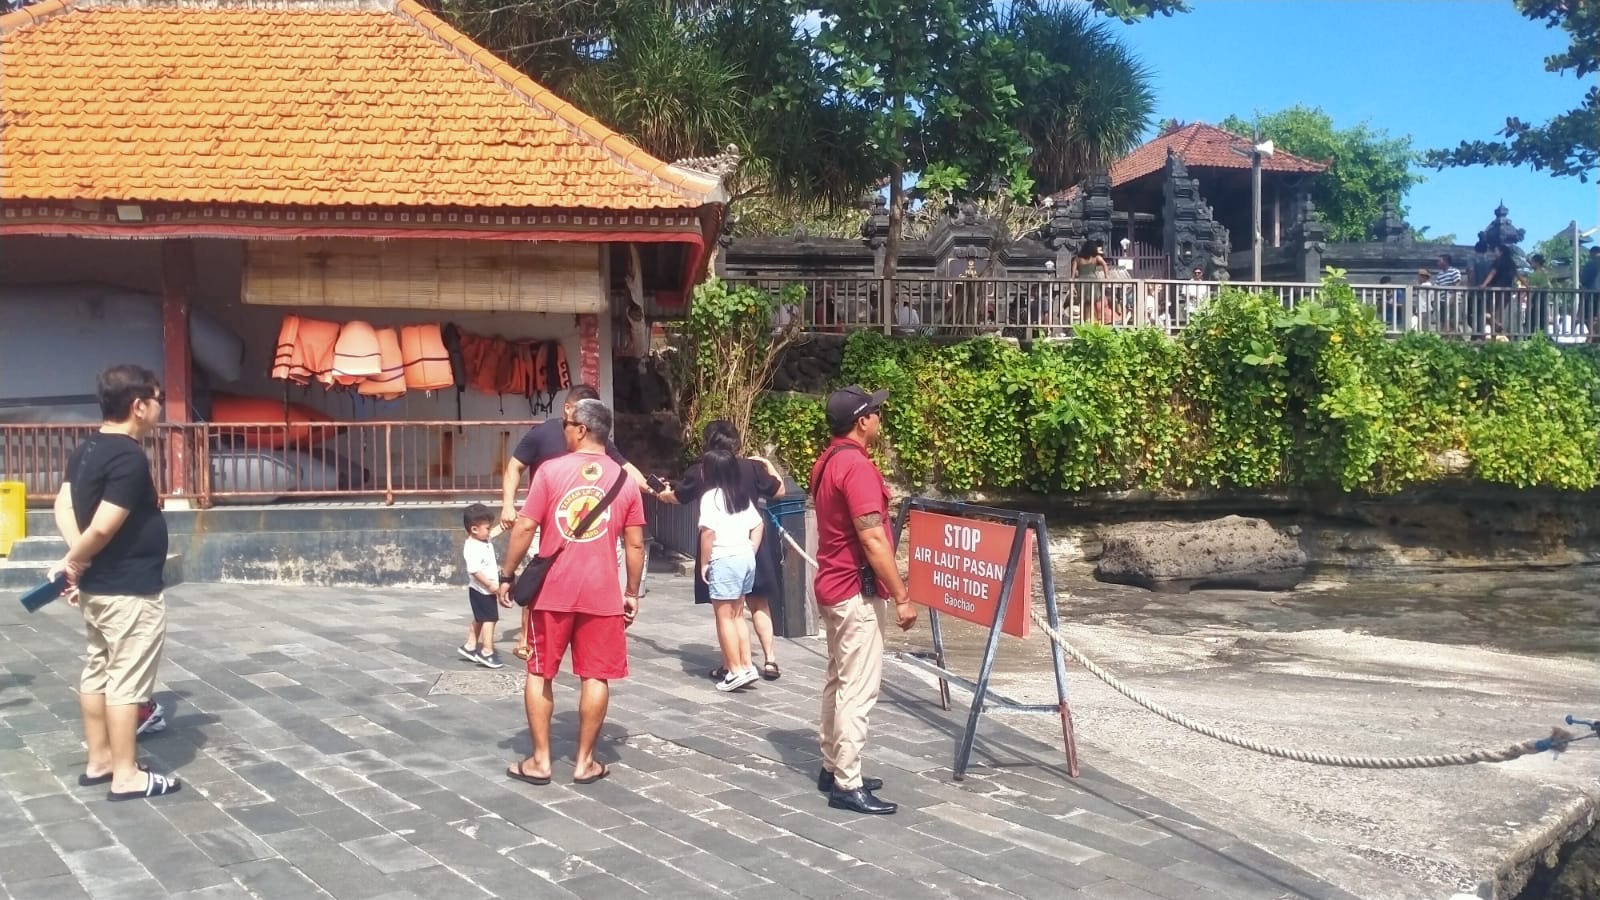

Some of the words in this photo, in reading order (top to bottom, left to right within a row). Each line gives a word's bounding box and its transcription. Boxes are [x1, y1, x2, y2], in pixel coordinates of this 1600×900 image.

[944, 523, 981, 553] STOP
[914, 546, 932, 563] AIR
[934, 550, 960, 570] LAUT
[963, 557, 1006, 582] PASAN
[933, 570, 960, 591] HIGH
[963, 578, 989, 600] TIDE
[944, 592, 975, 613] Gaochao
